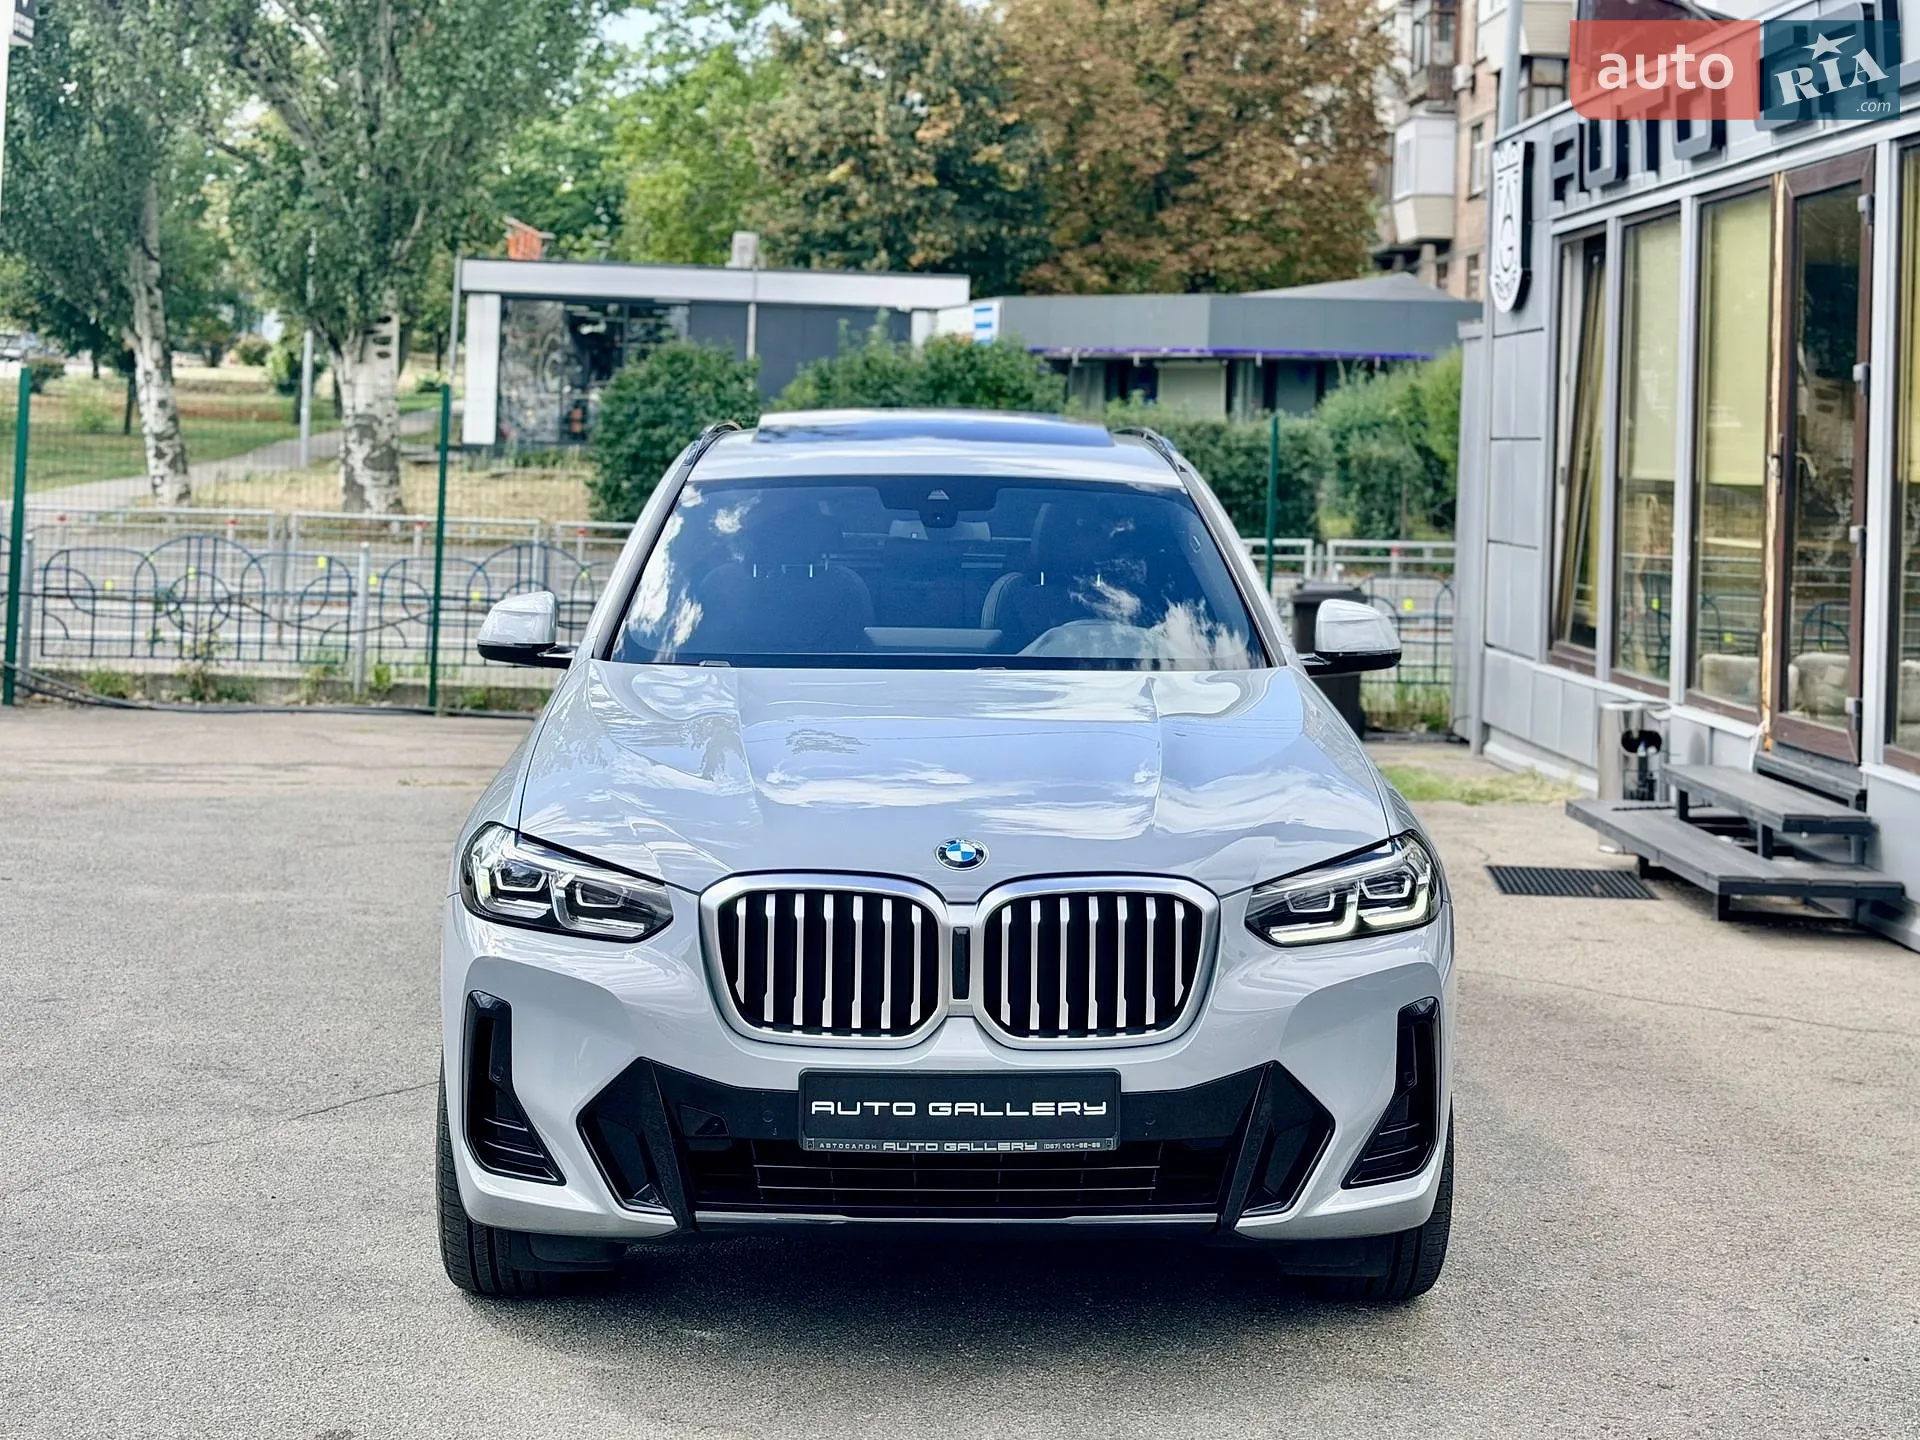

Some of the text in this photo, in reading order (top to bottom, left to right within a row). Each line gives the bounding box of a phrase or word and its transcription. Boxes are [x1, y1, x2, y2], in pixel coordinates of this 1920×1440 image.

[811, 1101, 1107, 1116] AUTO GALLERY
[883, 1142, 938, 1151] AUTO
[944, 1142, 1038, 1151] GALLERY
